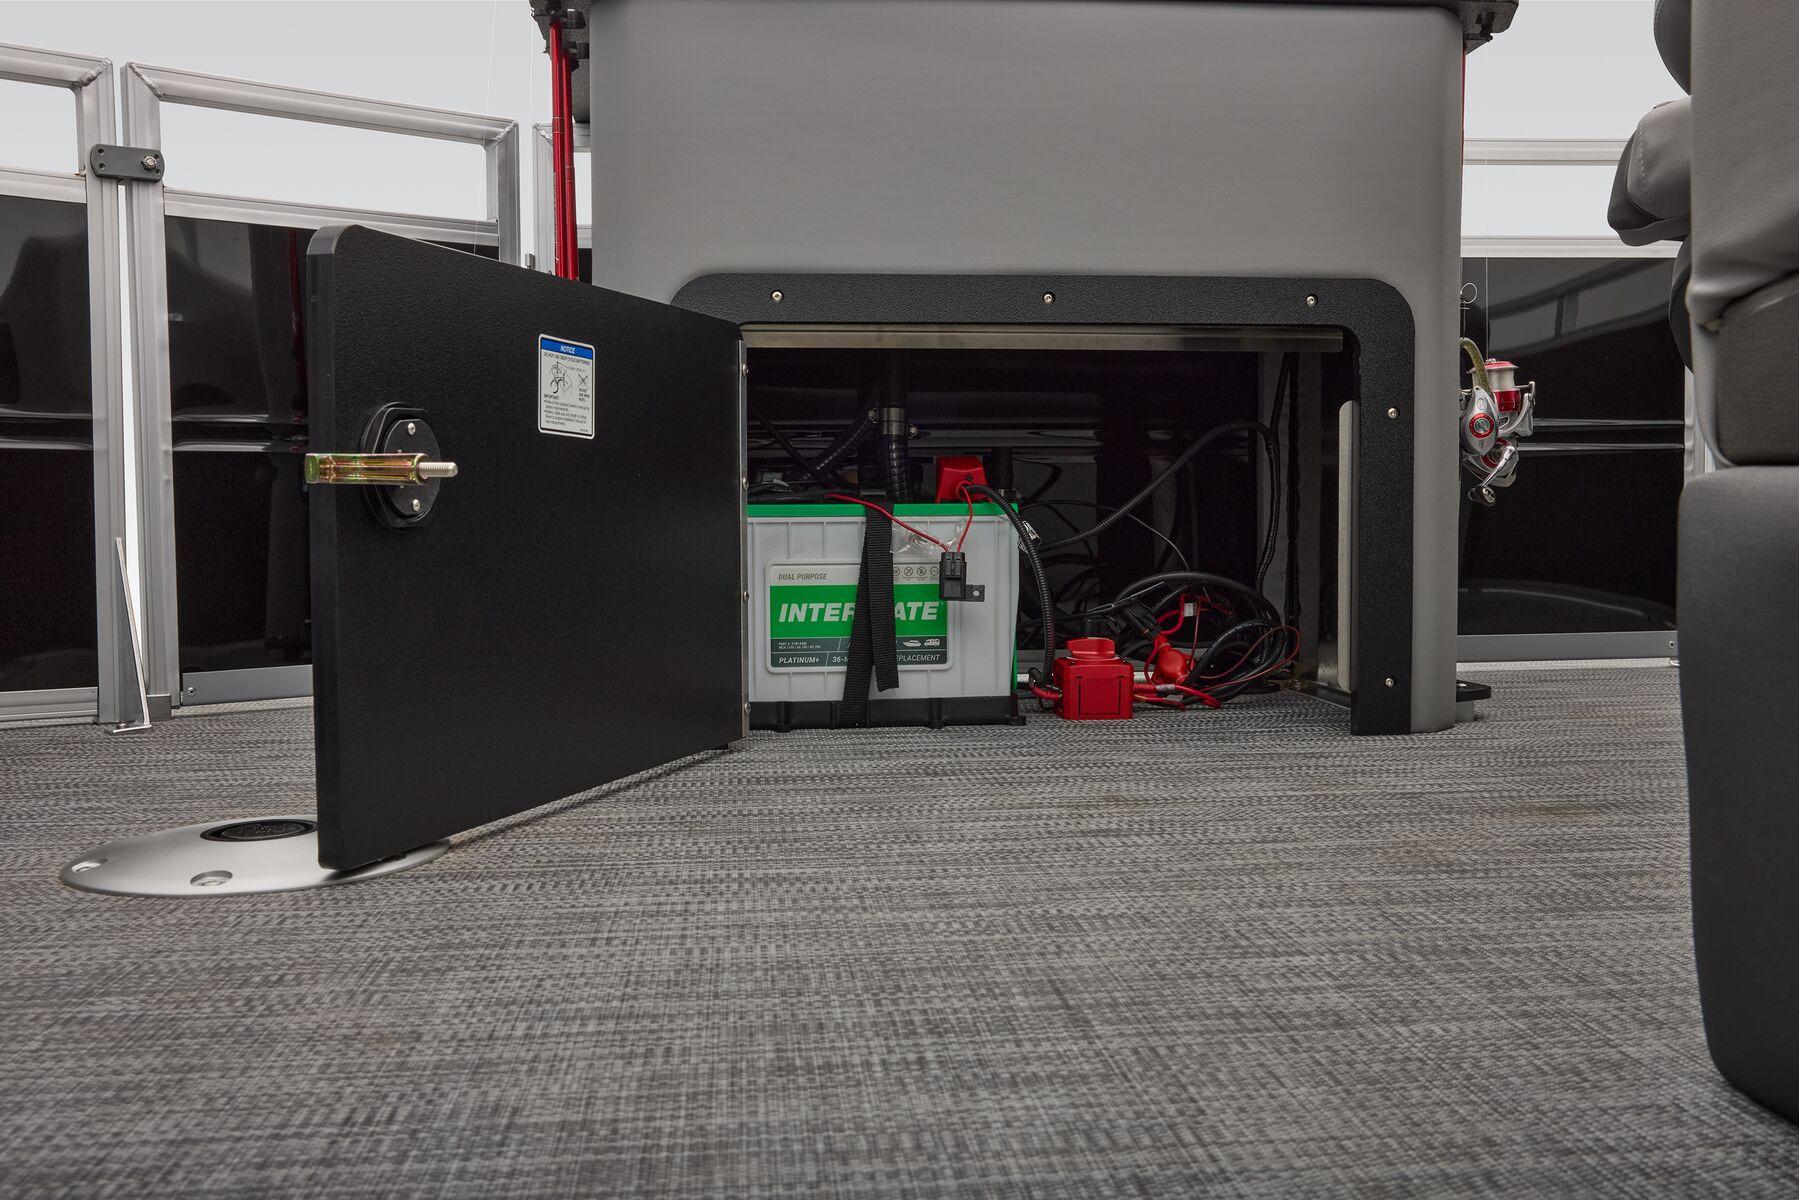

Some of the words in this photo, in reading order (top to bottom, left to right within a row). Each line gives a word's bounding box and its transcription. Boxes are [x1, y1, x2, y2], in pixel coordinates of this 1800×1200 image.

[560, 345, 576, 354] NOTICE
[779, 602, 939, 622] INTERATE
[778, 656, 820, 664] PLATINUM+
